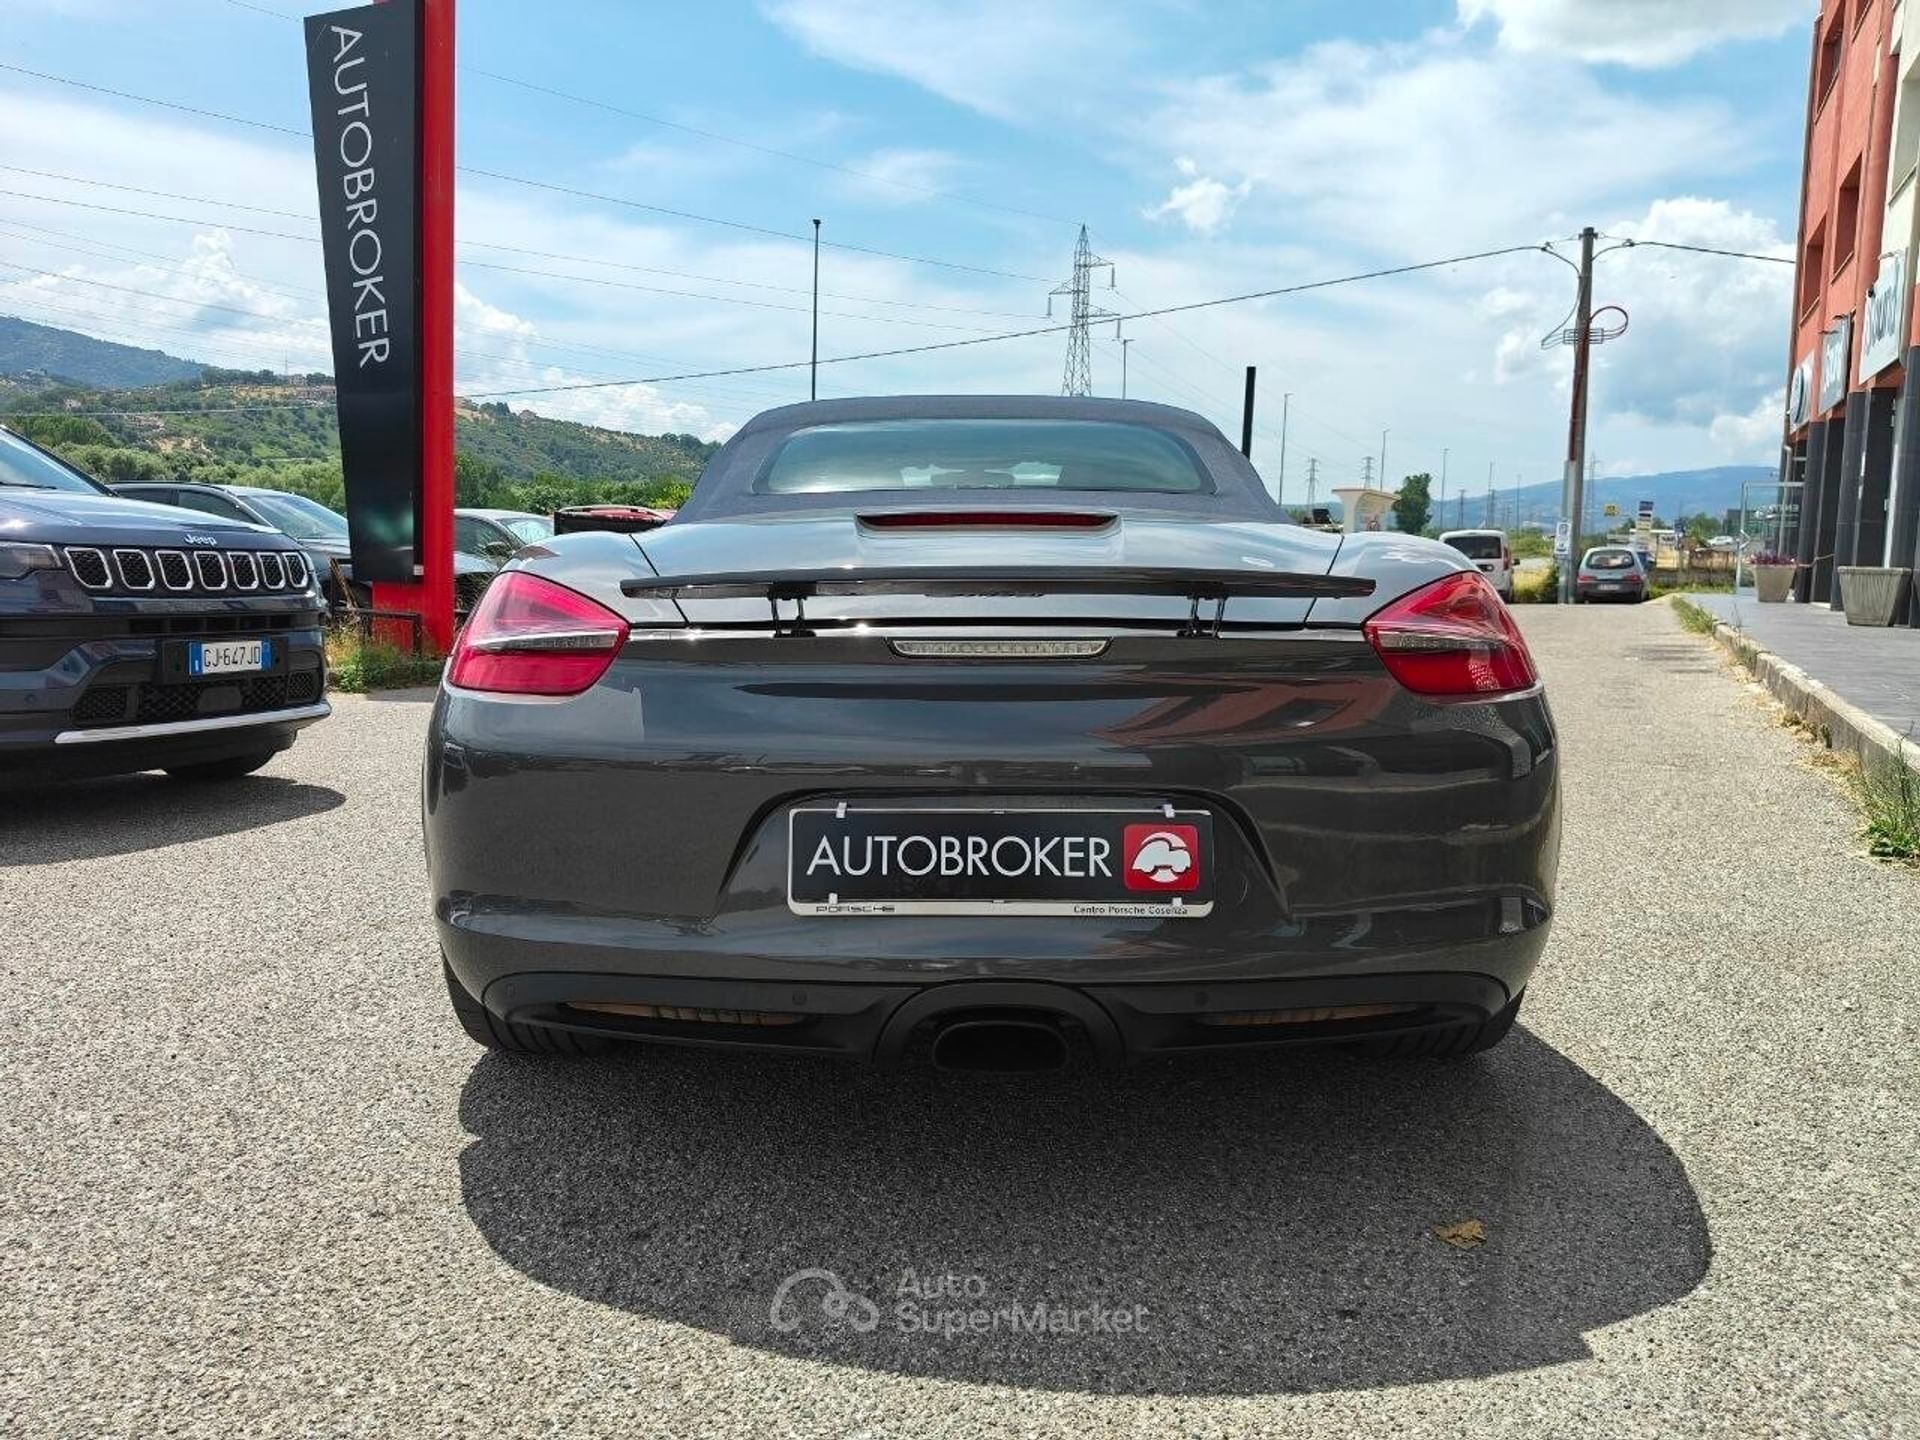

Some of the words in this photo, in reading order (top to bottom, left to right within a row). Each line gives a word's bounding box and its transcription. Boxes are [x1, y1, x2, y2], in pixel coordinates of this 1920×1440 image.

[331, 25, 391, 368] AUTOBROKER
[184, 533, 218, 547] Jeep
[806, 835, 1112, 878] AUTOBROKER
[1073, 905, 1105, 914] Centro
[1108, 905, 1146, 915] Porsche
